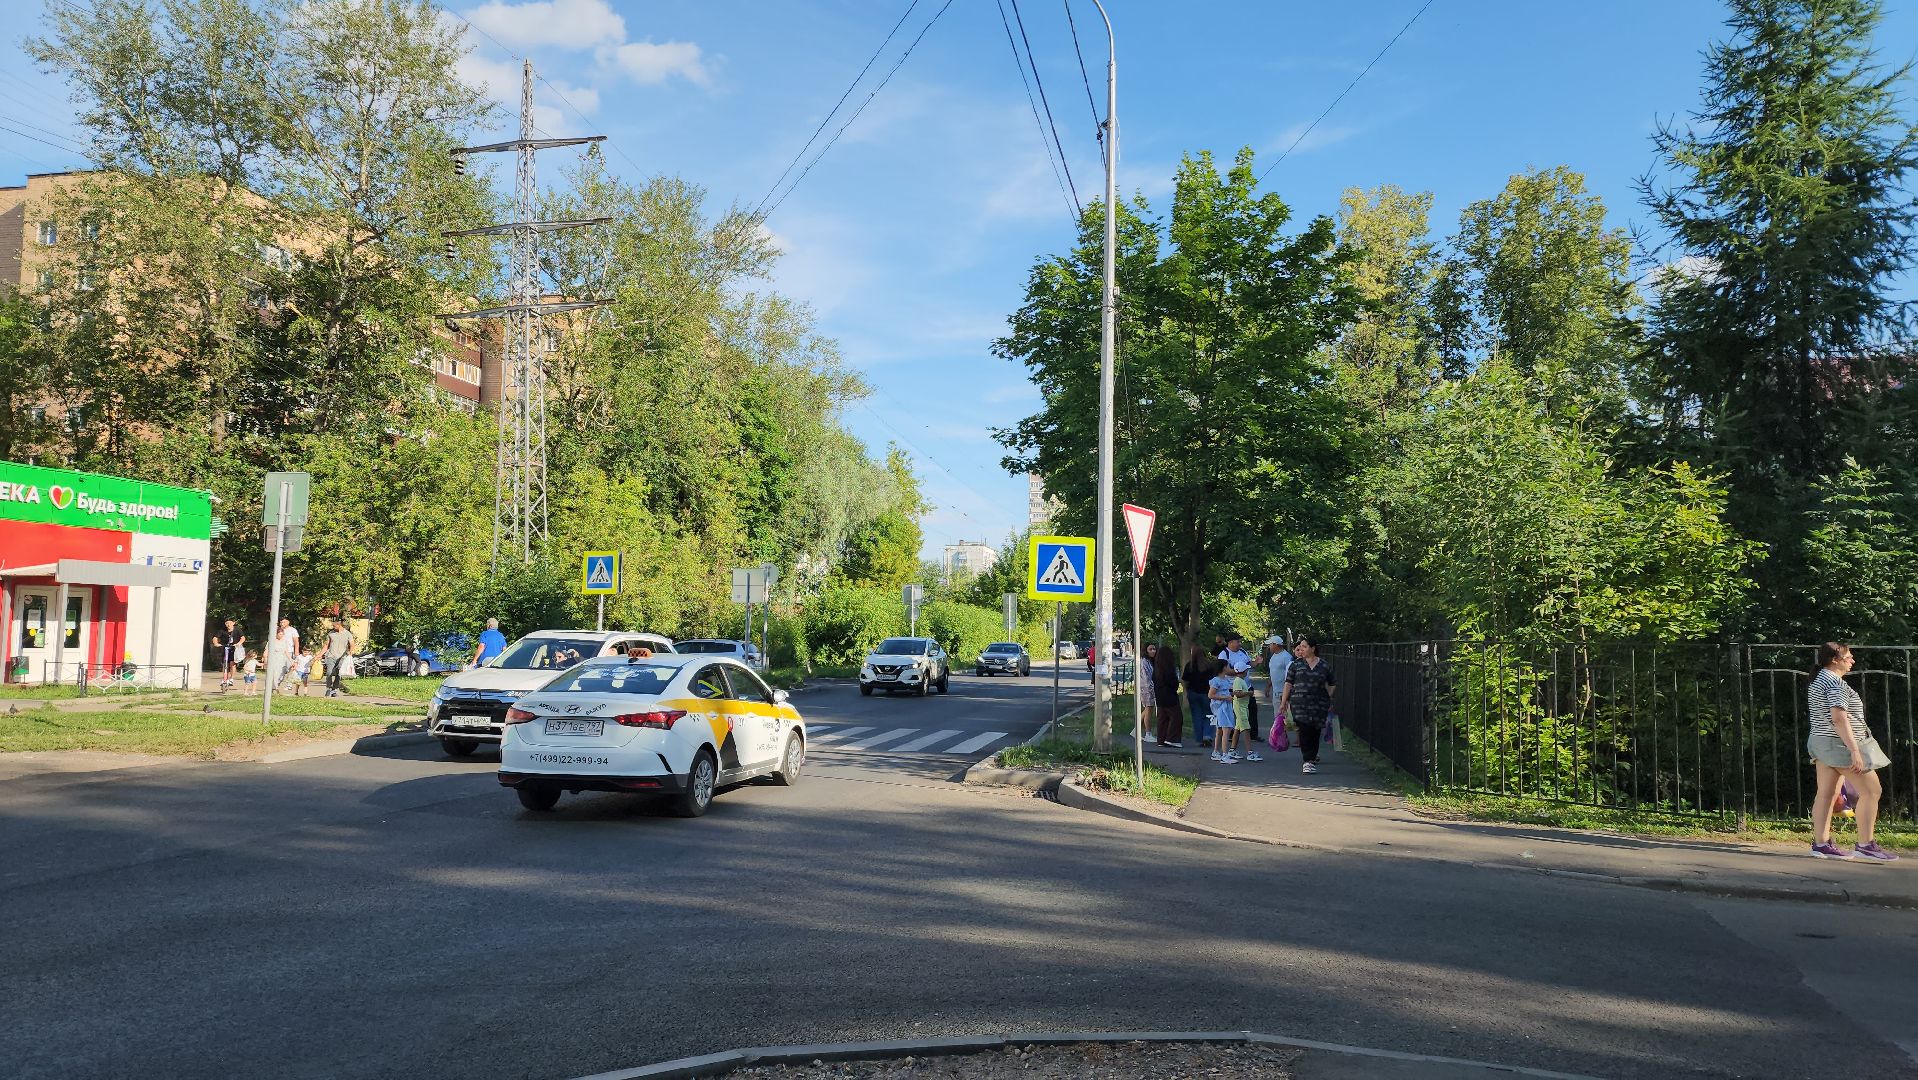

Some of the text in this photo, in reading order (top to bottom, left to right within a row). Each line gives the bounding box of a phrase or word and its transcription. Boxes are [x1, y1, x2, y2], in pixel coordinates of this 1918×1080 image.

[78, 492, 179, 521] Будь здоров!
[529, 753, 609, 765] +7(499)22-999-94
